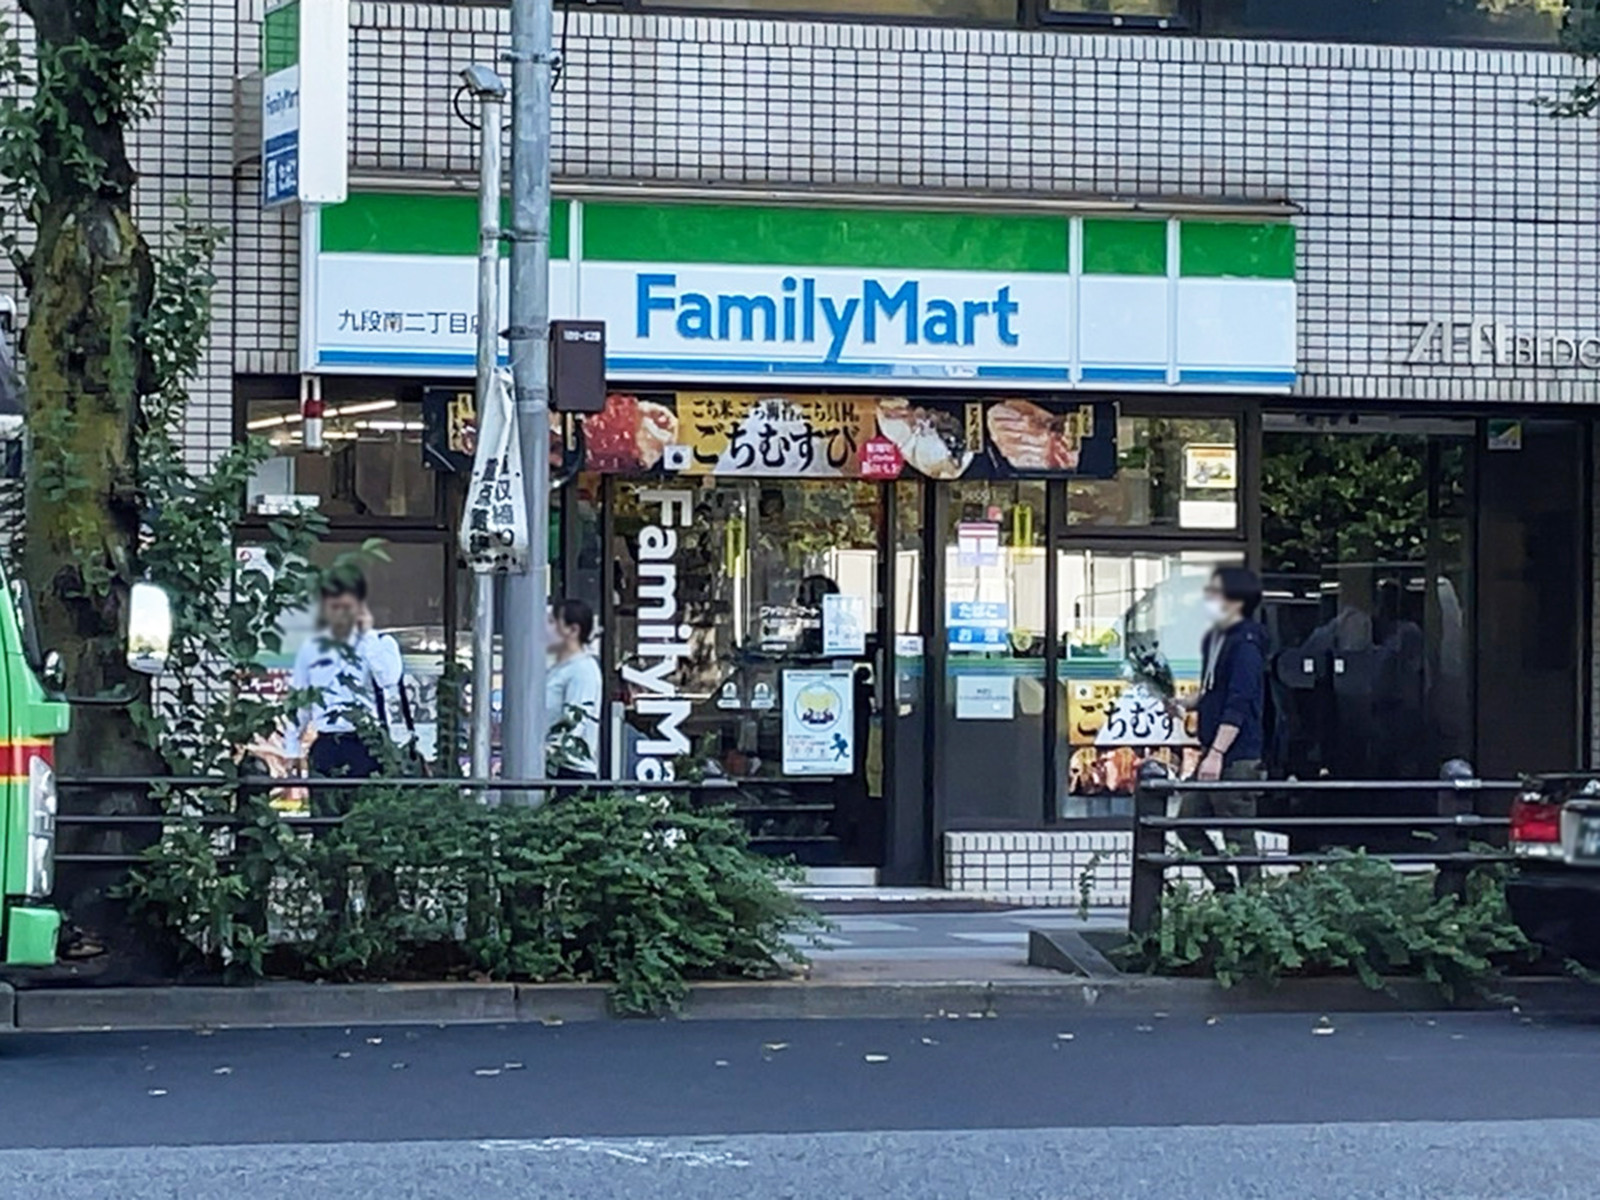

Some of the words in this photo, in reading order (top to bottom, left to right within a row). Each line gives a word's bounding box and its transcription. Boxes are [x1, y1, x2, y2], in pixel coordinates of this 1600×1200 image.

[636, 274, 1019, 363] FamilyMart
[693, 421, 861, 472] ごちむすび
[959, 602, 998, 618] たばこ
[621, 489, 693, 850] FamilyMa
